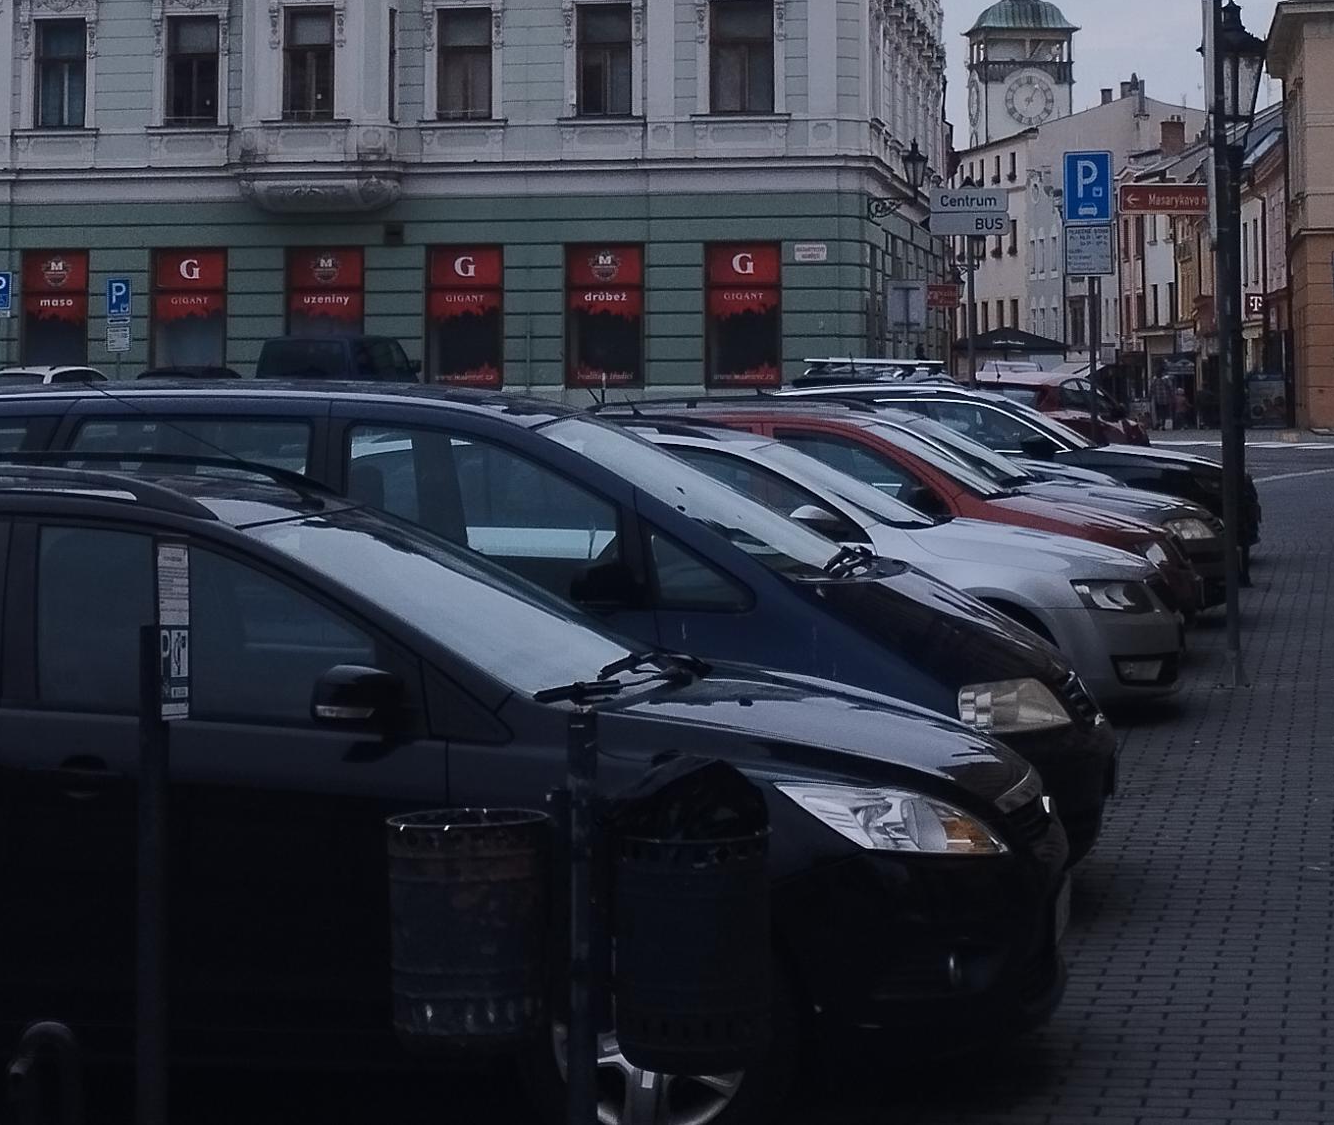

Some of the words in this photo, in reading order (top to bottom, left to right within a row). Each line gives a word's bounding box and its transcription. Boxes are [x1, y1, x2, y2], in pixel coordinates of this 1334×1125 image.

[1077, 160, 1098, 199] P
[940, 194, 997, 207] Centrum
[1148, 193, 1200, 209] Masarykovo
[975, 218, 1004, 230] BUS
[51, 261, 63, 271] M
[319, 258, 333, 268] M
[598, 255, 612, 265] M
[731, 253, 754, 274] G
[179, 259, 200, 280] G
[454, 256, 476, 277] G
[112, 282, 126, 304] P
[445, 294, 485, 303] GIGANT
[584, 291, 628, 301] drůbež
[723, 292, 764, 300] GIGANT
[40, 299, 73, 307] maso
[171, 296, 209, 305] GIGANT
[303, 294, 349, 306] uzeniny
